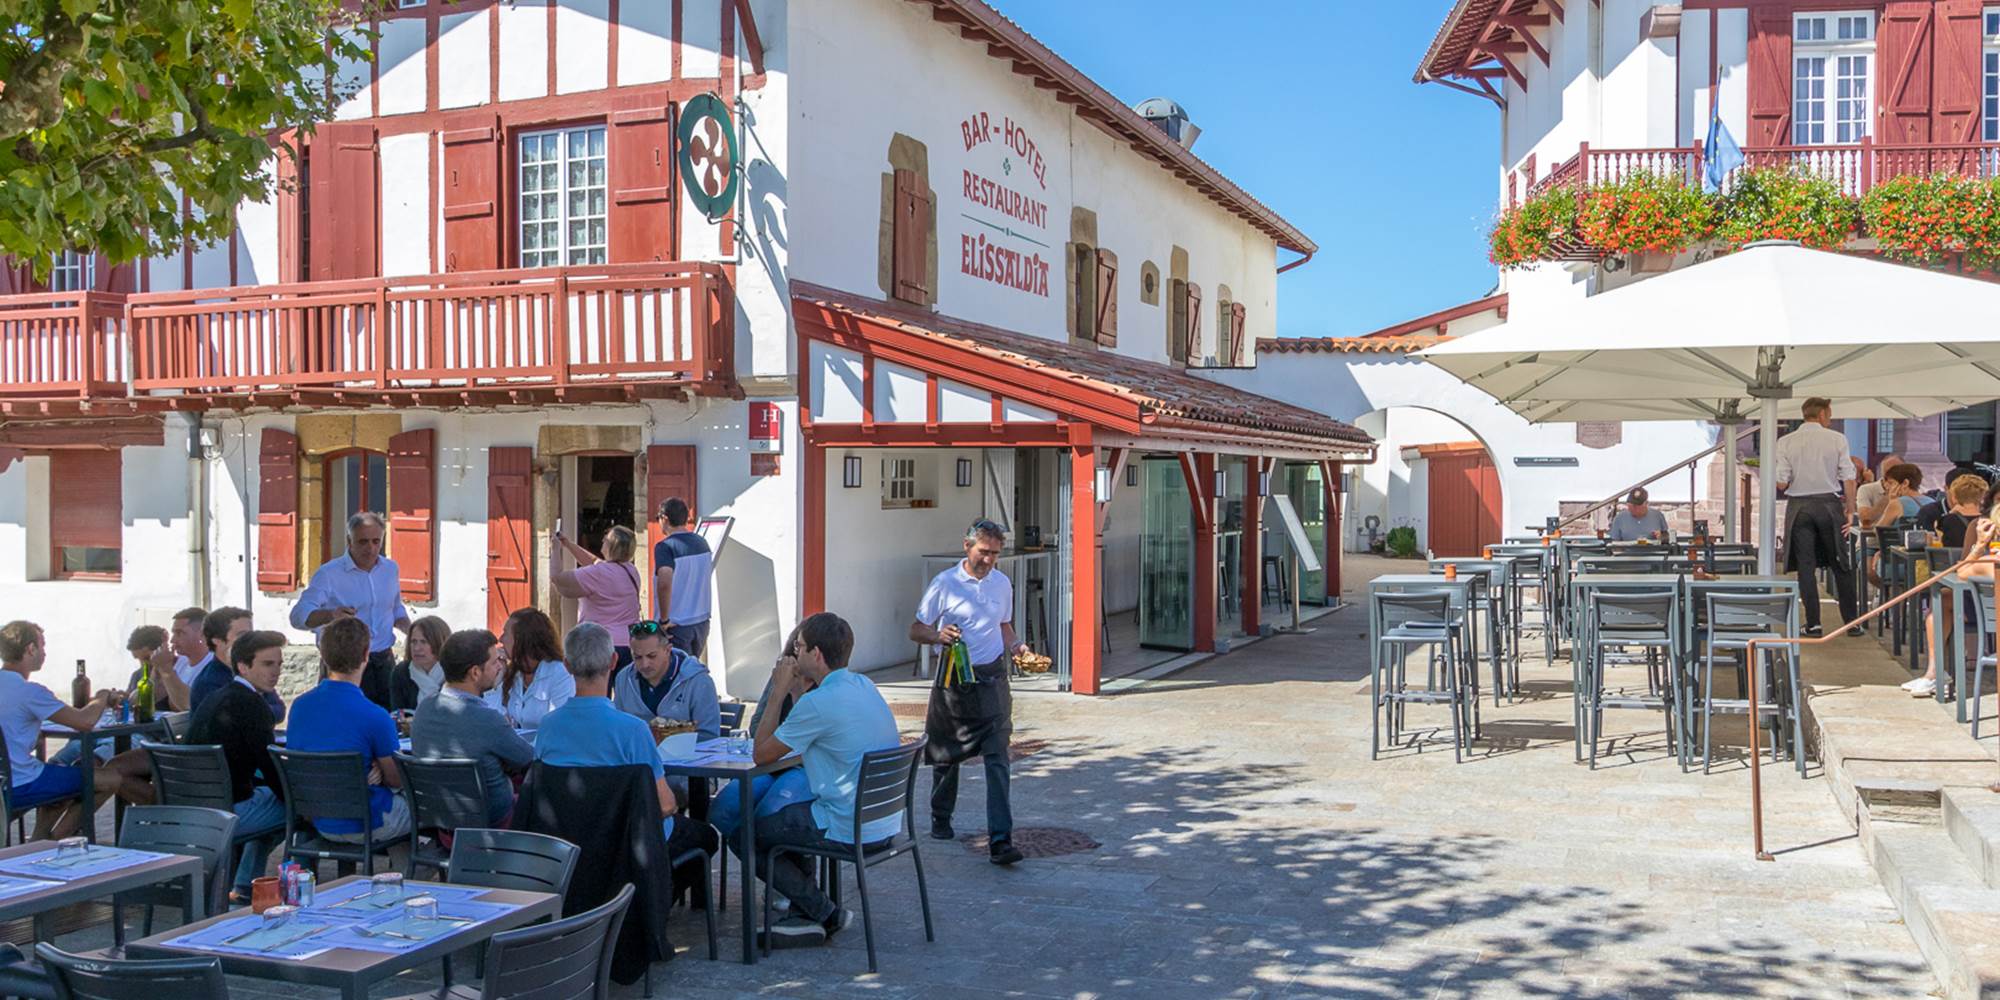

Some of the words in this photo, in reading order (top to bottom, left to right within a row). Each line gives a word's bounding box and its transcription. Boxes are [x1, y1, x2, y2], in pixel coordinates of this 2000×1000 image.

[961, 112, 991, 152] BAR
[1004, 116, 1046, 190] HOTEL
[963, 169, 1047, 229] RESTAURANT
[762, 409, 778, 422] H
